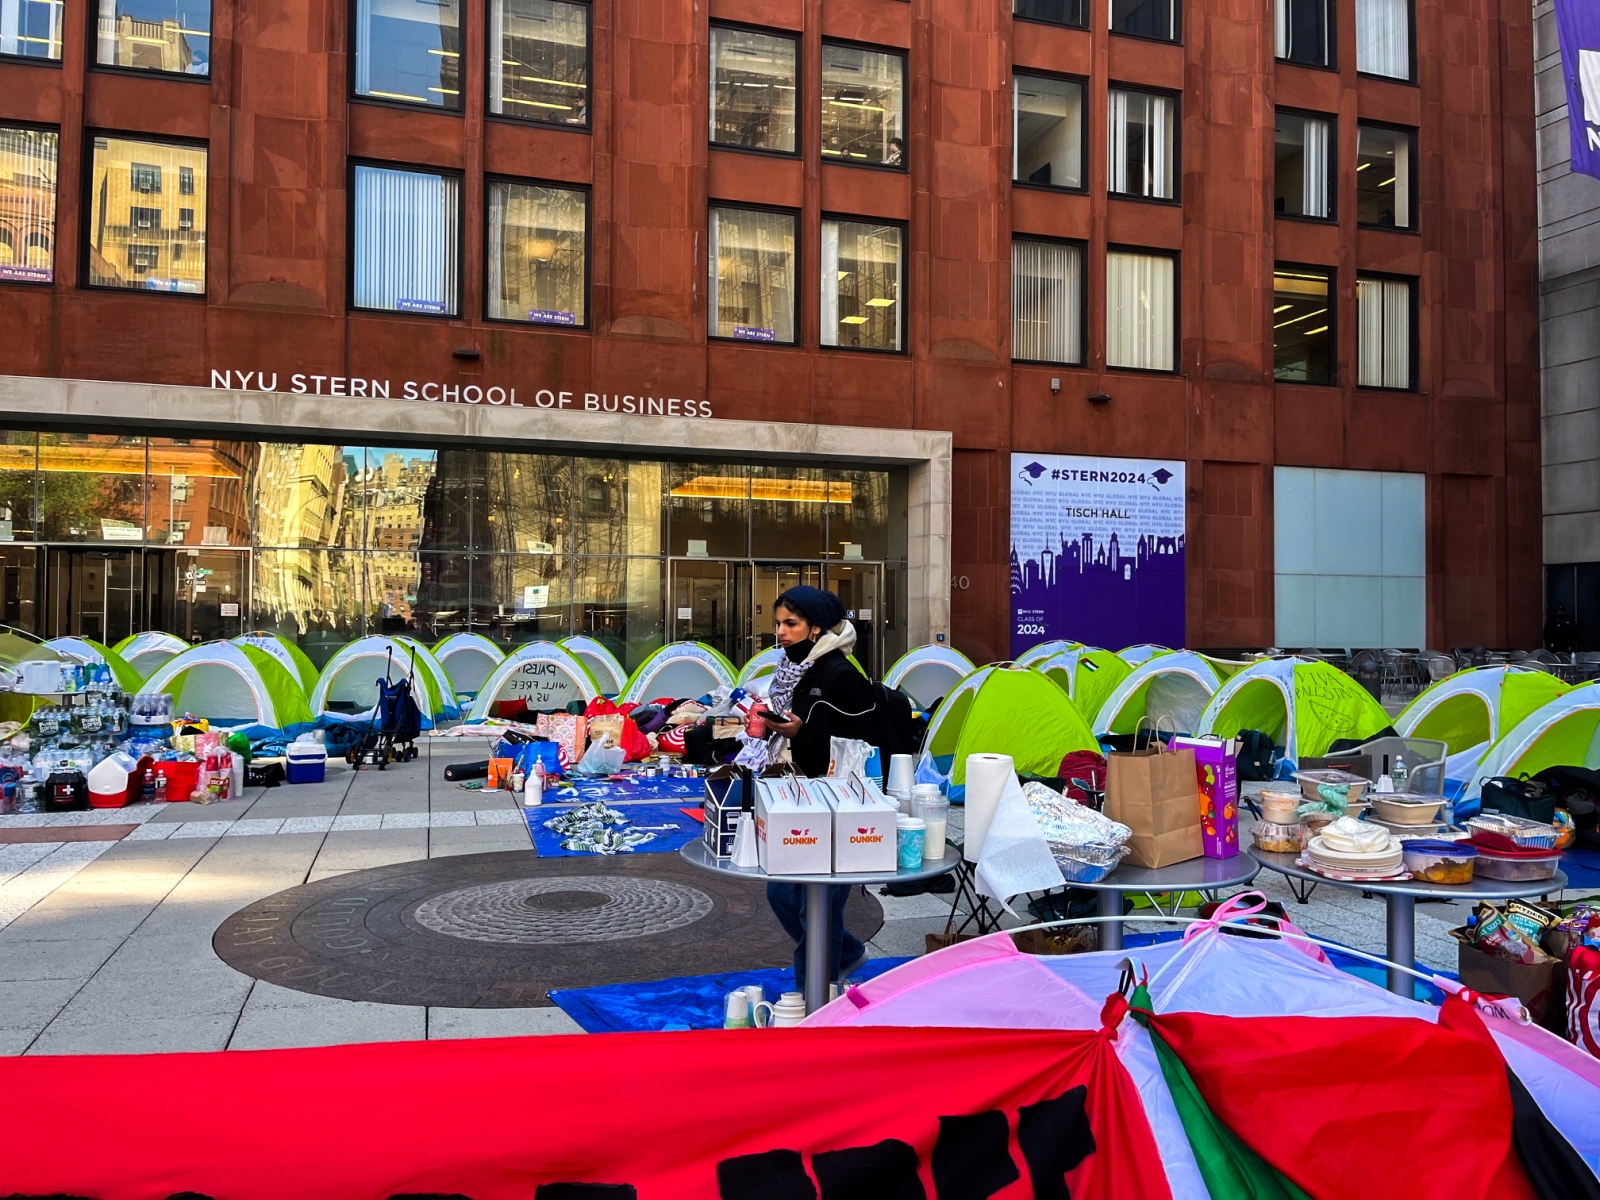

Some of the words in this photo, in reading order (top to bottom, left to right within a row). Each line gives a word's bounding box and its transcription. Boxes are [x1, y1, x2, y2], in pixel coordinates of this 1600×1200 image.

[27, 271, 46, 279] STERN
[210, 368, 278, 392] NYU
[290, 374, 390, 399] STERN
[403, 381, 524, 408] SCHOOL
[534, 389, 573, 410] OF
[585, 393, 713, 418] BUSINESS
[1051, 469, 1146, 484] #STERN2024
[1066, 508, 1098, 518] TISCH
[1102, 508, 1131, 519] HALL
[951, 575, 970, 590] 40
[1017, 624, 1045, 634] 2024
[1299, 672, 1344, 687] VIVA
[1296, 686, 1368, 702] PALESTINA
[850, 836, 883, 844] DUNKIN'
[312, 896, 368, 950] GOULD
[234, 916, 280, 947] JAY
